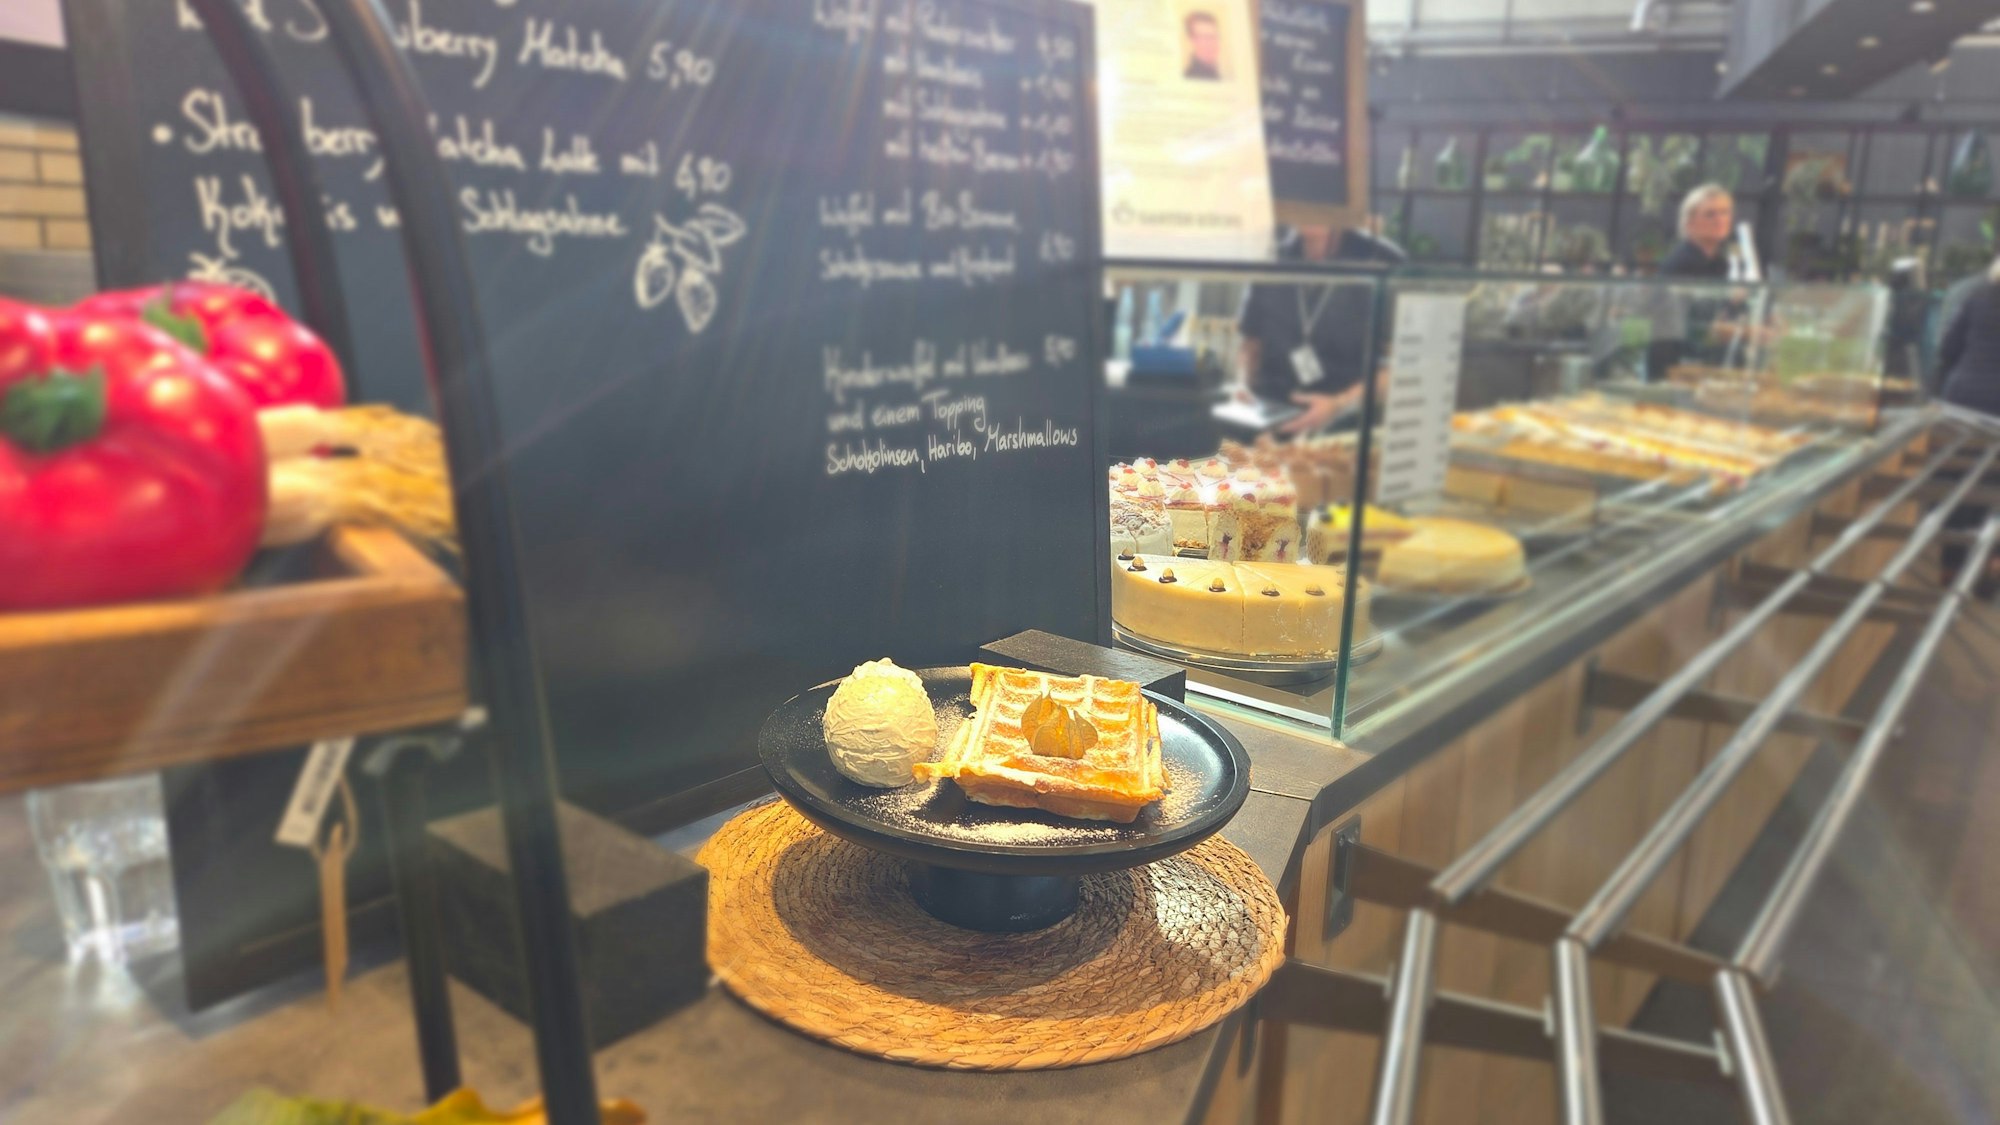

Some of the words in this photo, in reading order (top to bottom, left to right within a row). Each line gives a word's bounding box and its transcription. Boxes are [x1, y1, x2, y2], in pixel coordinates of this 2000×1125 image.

[518, 16, 627, 81] Matcha
[647, 39, 716, 89] 5,90
[426, 111, 527, 172] atcha
[619, 138, 660, 177] mit
[827, 398, 864, 433] und
[871, 402, 920, 427] einem
[921, 389, 987, 433] Topping
[927, 429, 977, 461] Haribo,
[984, 415, 1079, 453] Marshmallows
